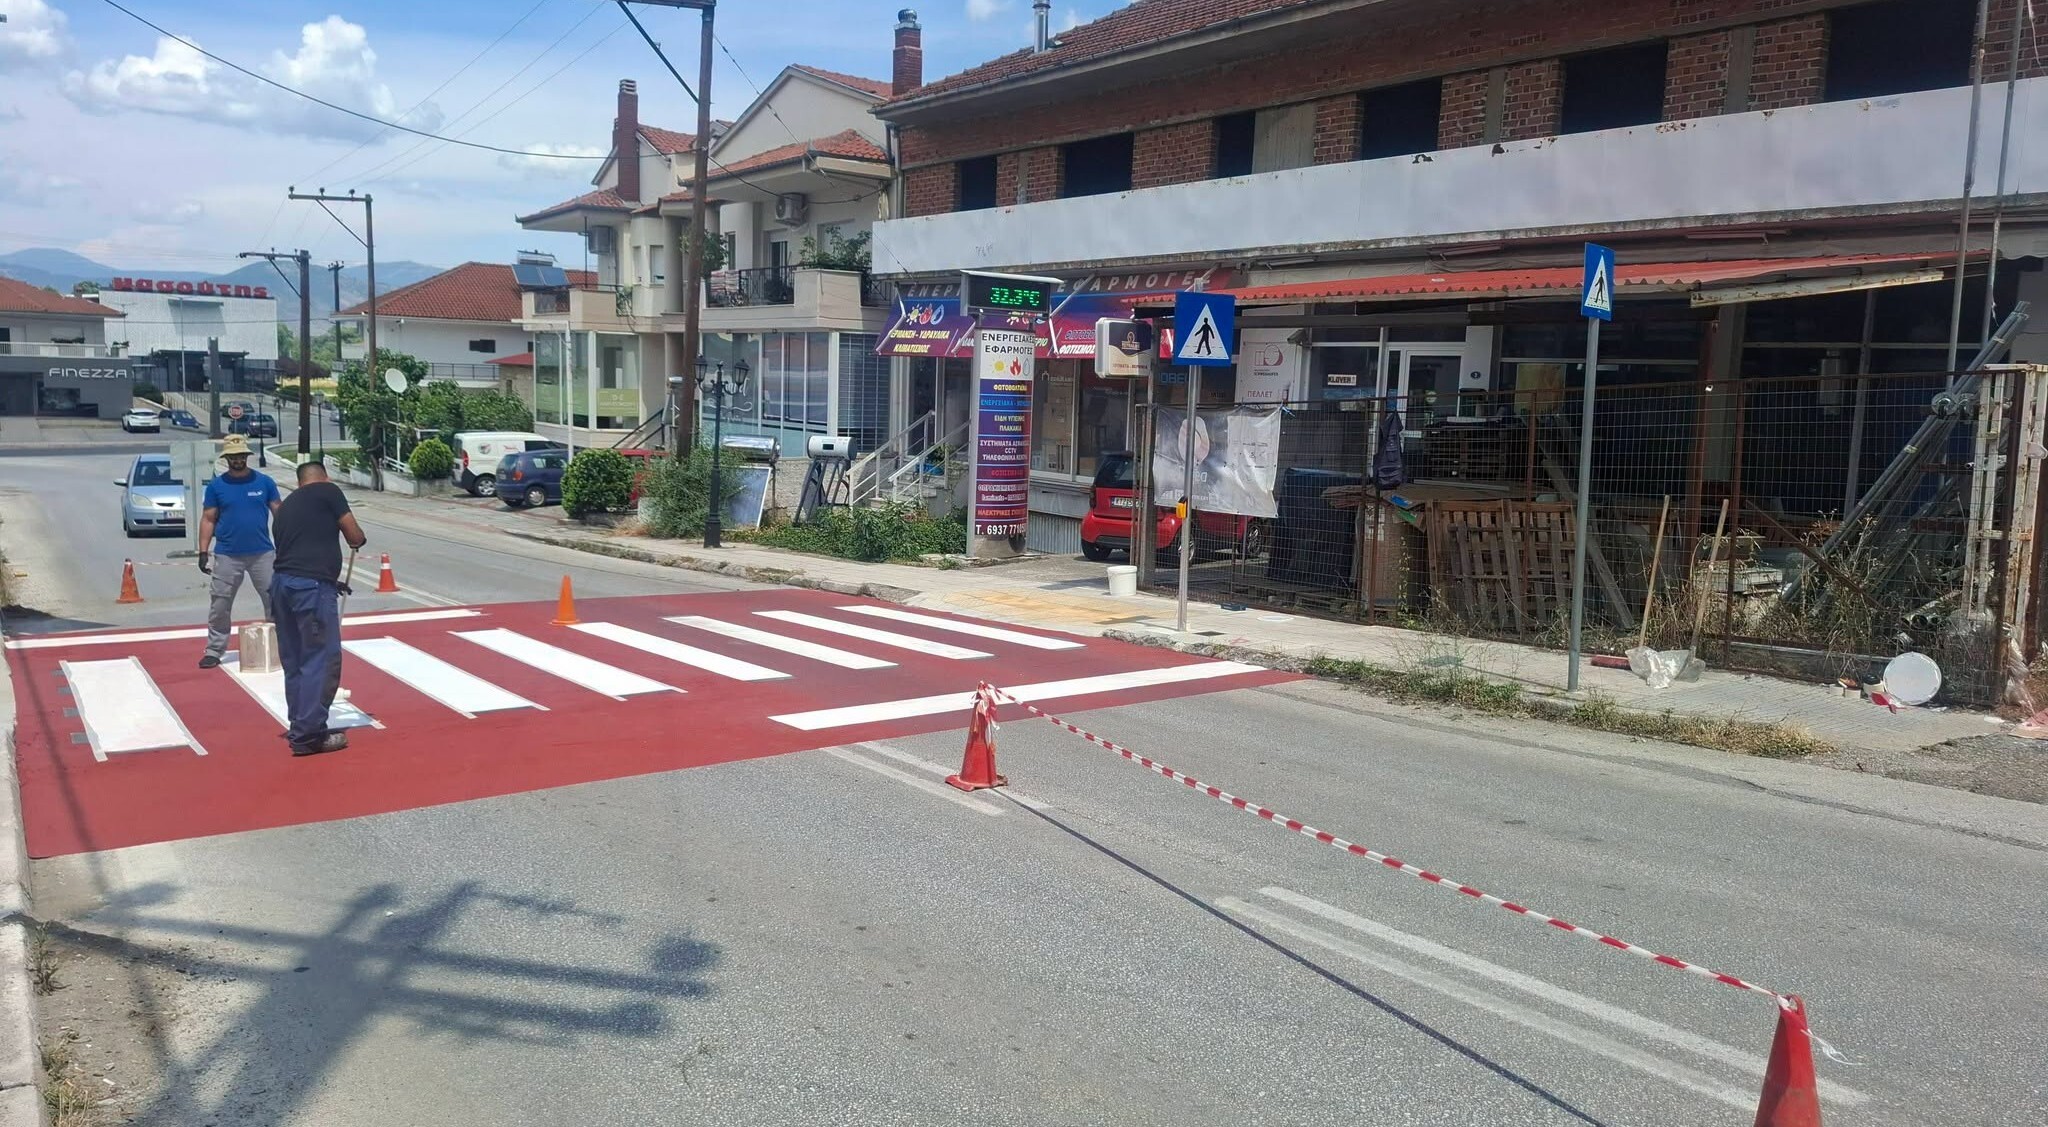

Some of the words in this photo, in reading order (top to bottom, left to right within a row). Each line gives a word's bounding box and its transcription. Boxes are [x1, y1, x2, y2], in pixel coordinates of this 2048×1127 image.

[985, 345, 1033, 355] ΕΦΑΡΜΟΓΕΣ
[49, 368, 127, 379] FINEZZA
[1247, 390, 1273, 398] ΠΕΛΛΕΤ
[987, 525, 1007, 535] 6937
